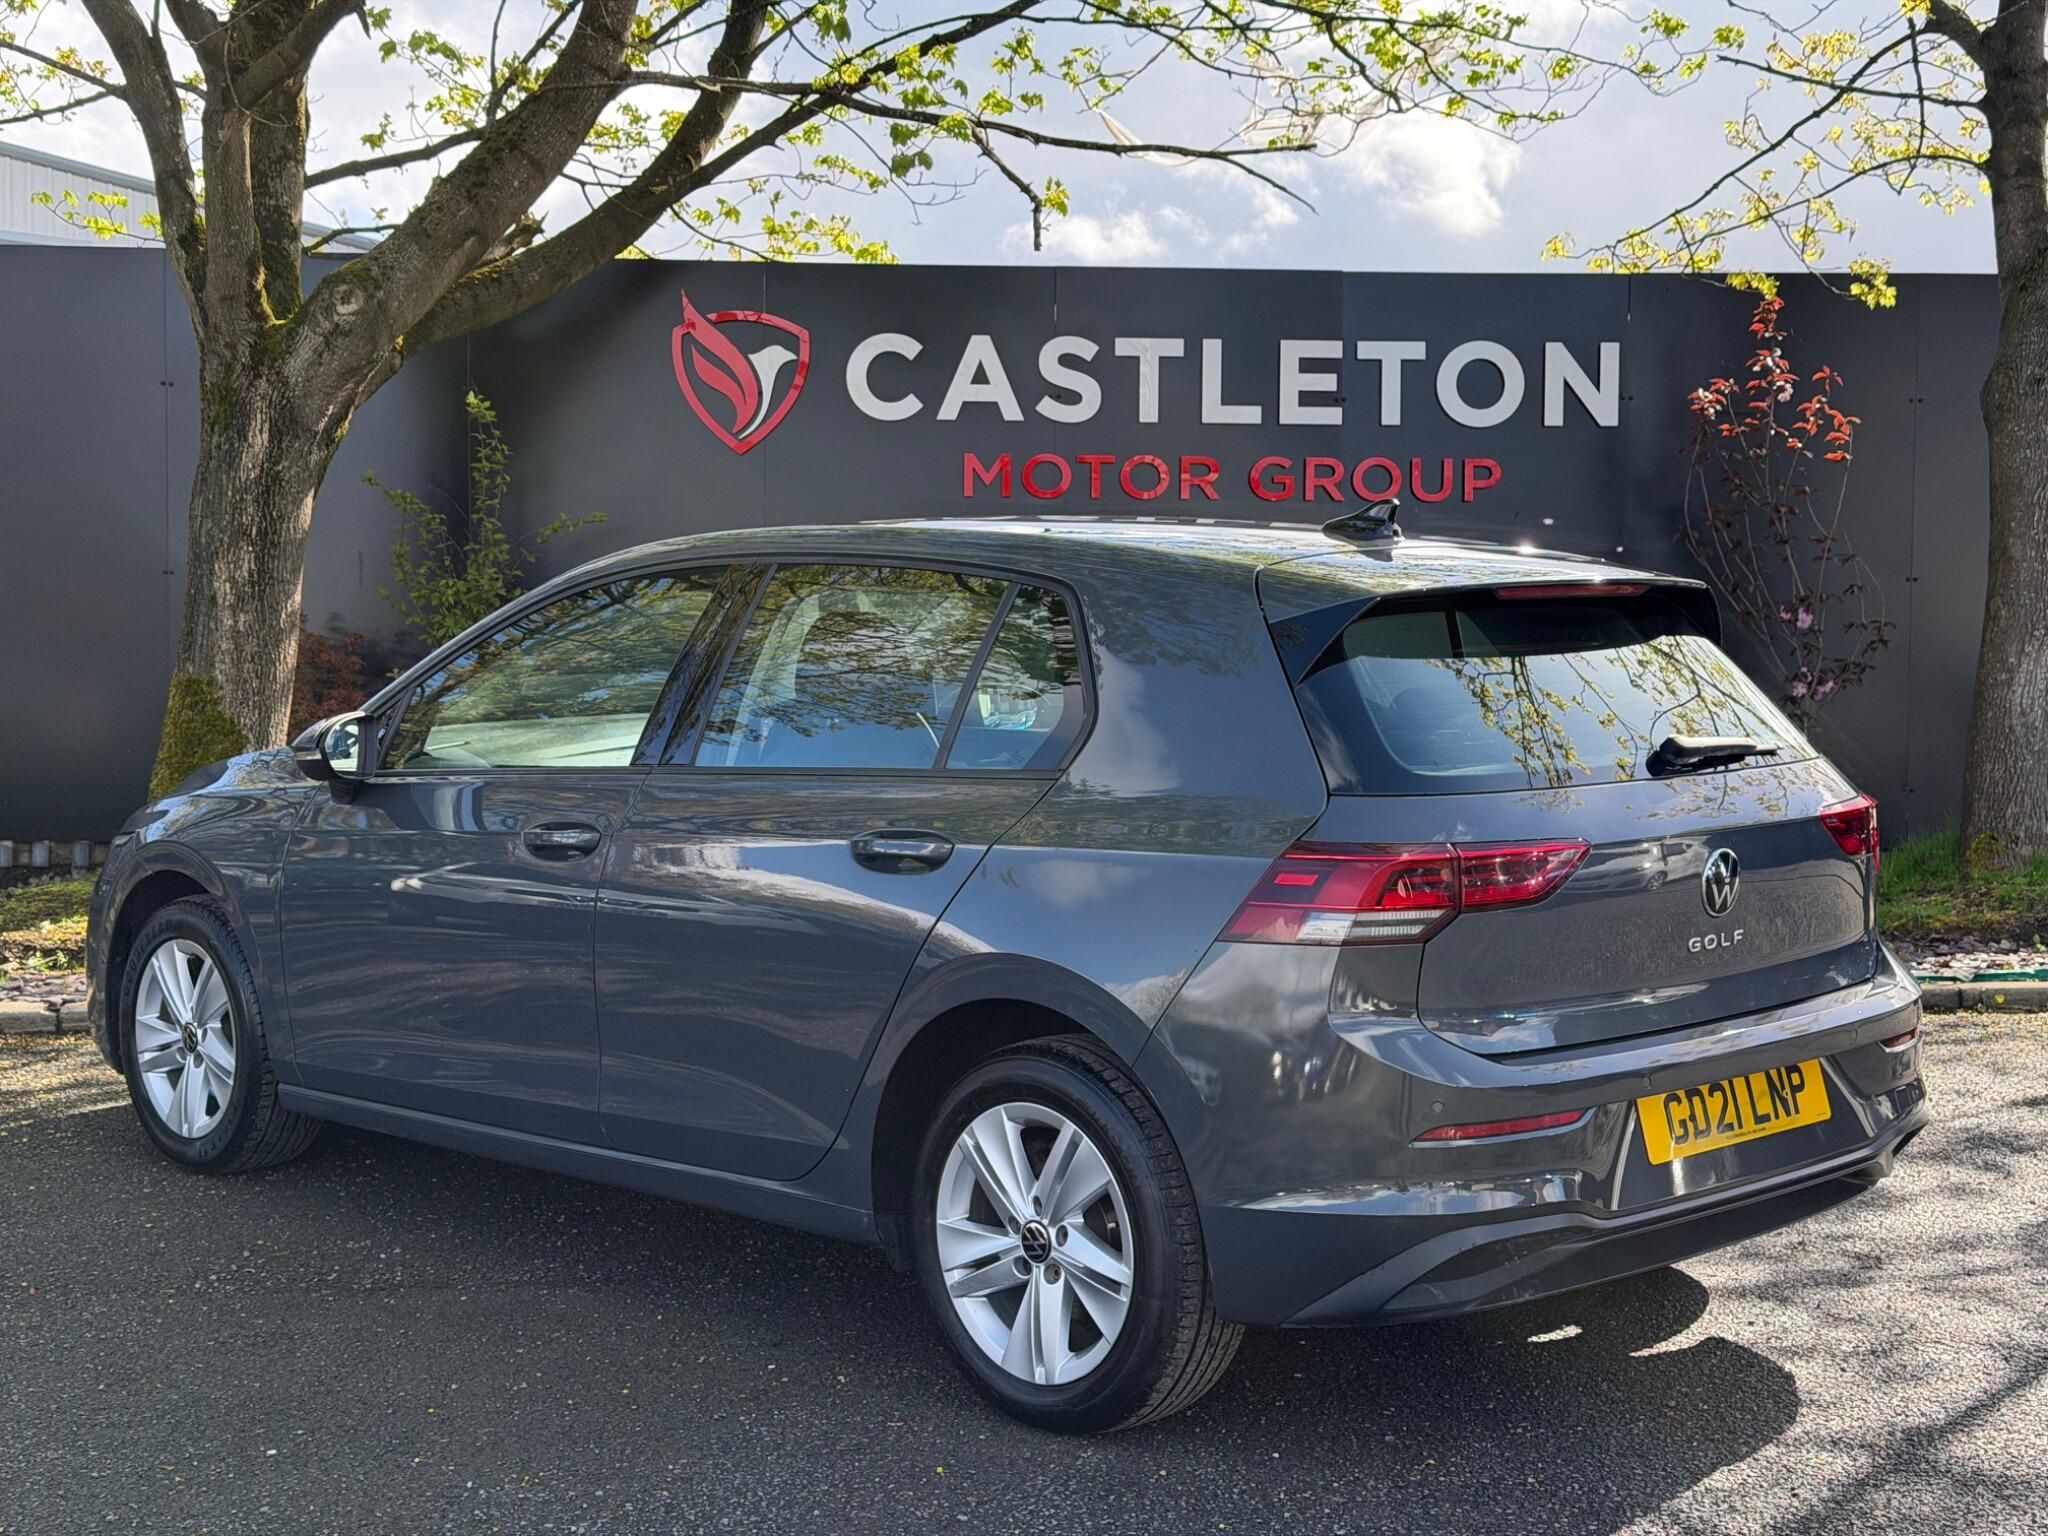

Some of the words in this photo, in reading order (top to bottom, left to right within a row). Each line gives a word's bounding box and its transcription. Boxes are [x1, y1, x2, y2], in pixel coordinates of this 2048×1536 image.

[846, 333, 1620, 428] CASTLETON
[963, 453, 1221, 501] MOTOR
[1249, 456, 1503, 503] GROUP
[1688, 929, 1745, 953] GOLF
[1663, 1079, 1744, 1146] GD21
[1744, 1064, 1805, 1126] LNP
